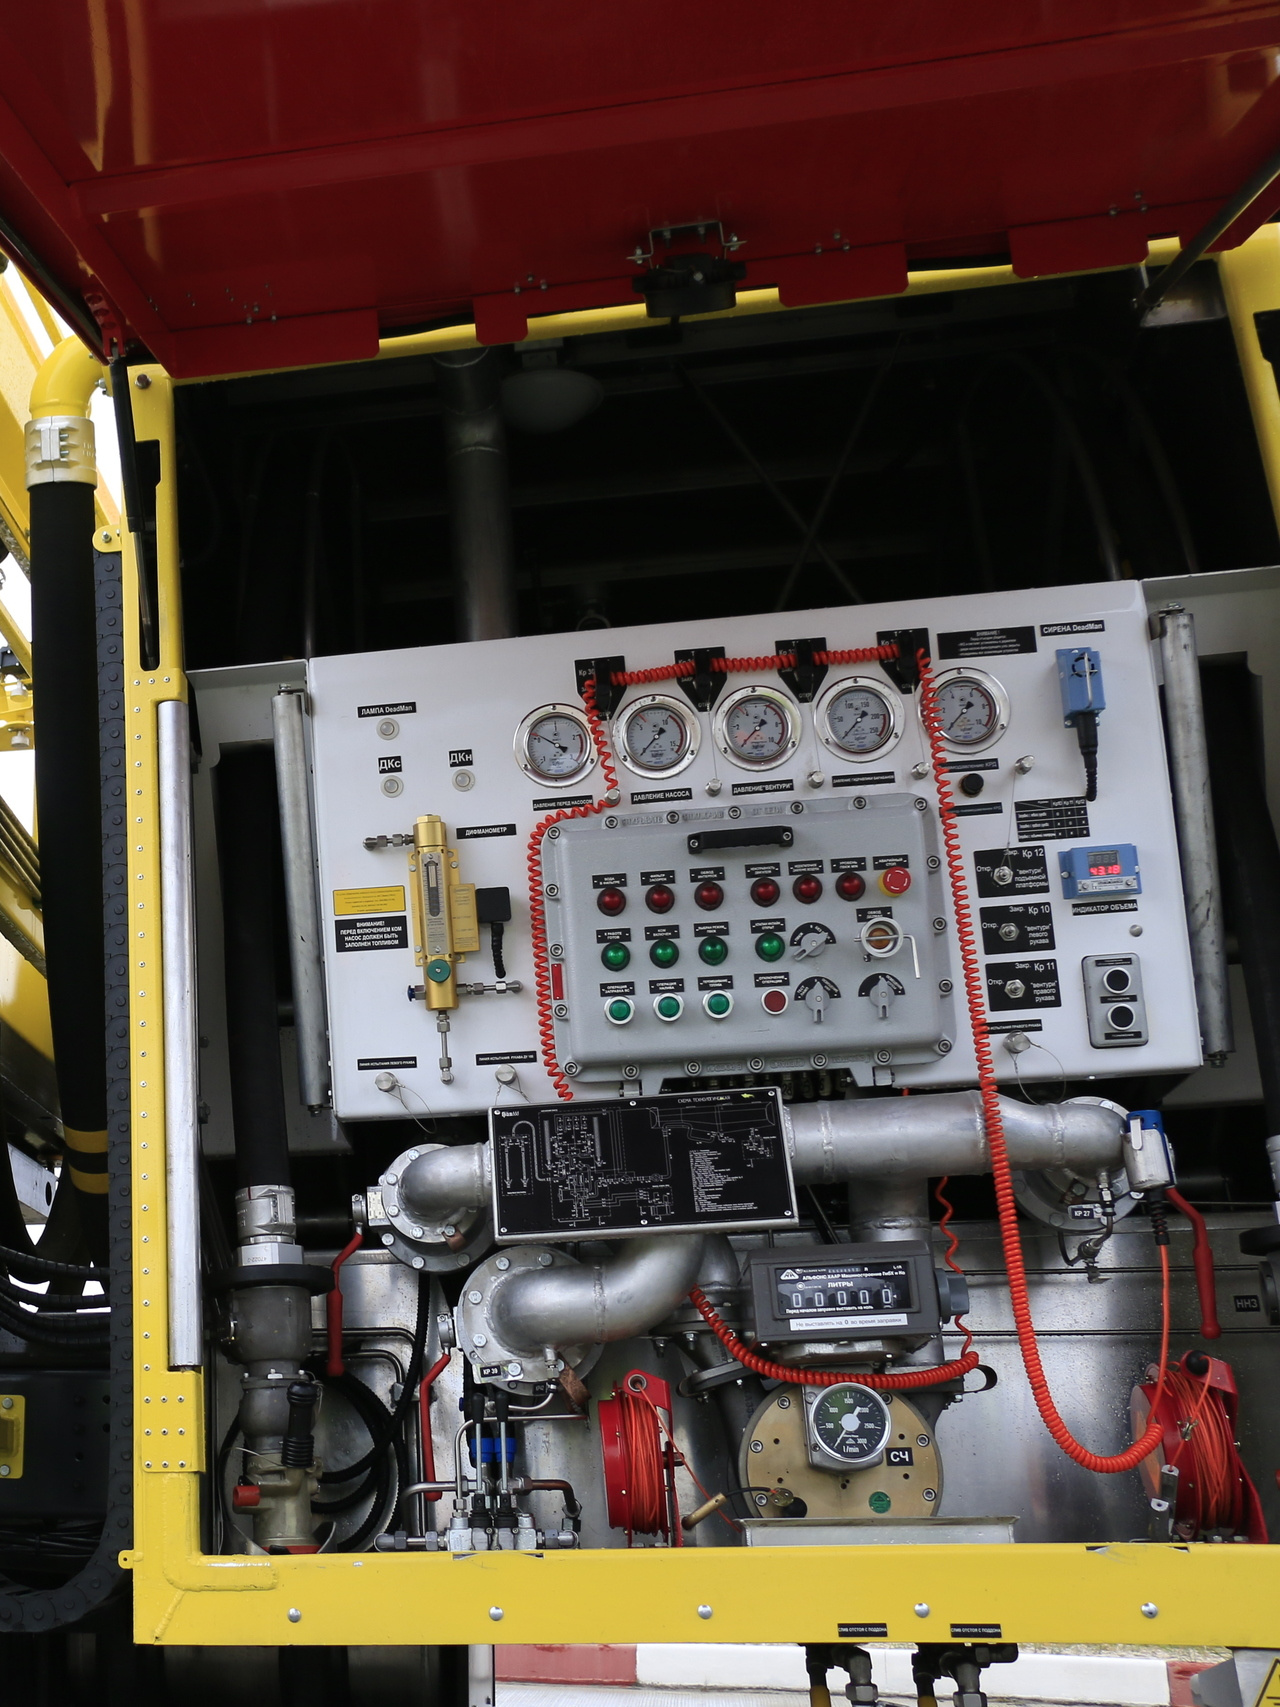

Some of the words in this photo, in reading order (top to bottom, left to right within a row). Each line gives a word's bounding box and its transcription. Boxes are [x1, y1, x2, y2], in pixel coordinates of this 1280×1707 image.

[1043, 626, 1071, 634] СИРЕНА
[1072, 623, 1103, 631] DeadMan
[361, 707, 384, 715] ЛАМПА
[385, 705, 413, 713] DeadMan
[450, 752, 472, 764] ДКн
[380, 760, 401, 771] ДКс
[633, 792, 664, 801] ДАВЛЕНИЕ
[665, 790, 690, 798] НАСОСА
[533, 801, 556, 810] ДАВЛЕНИЕ
[465, 827, 508, 836] ДИФМАНОМЕТР
[1022, 850, 1033, 859] Кр
[1034, 848, 1045, 857] 12
[976, 865, 993, 873] Откр.
[1028, 906, 1039, 915] Кр
[1040, 905, 1050, 914] 10
[1072, 904, 1109, 914] ИНДИКАТОР
[1110, 902, 1138, 911] ОБЪЕМА
[981, 922, 999, 930] Откр.
[1029, 938, 1050, 946] рукава
[1015, 962, 1032, 970] Закр.
[1034, 963, 1045, 972] Кр
[1046, 962, 1055, 970] 11
[987, 978, 1005, 986] Откр.
[1033, 987, 1056, 995] правого
[1035, 994, 1055, 1002] рукава
[792, 1292, 802, 1308] 0
[814, 1292, 825, 1307] 0
[837, 1290, 847, 1306] 0
[860, 1289, 870, 1305] 0
[882, 1288, 892, 1304] 0
[889, 1450, 910, 1463] СЧ
